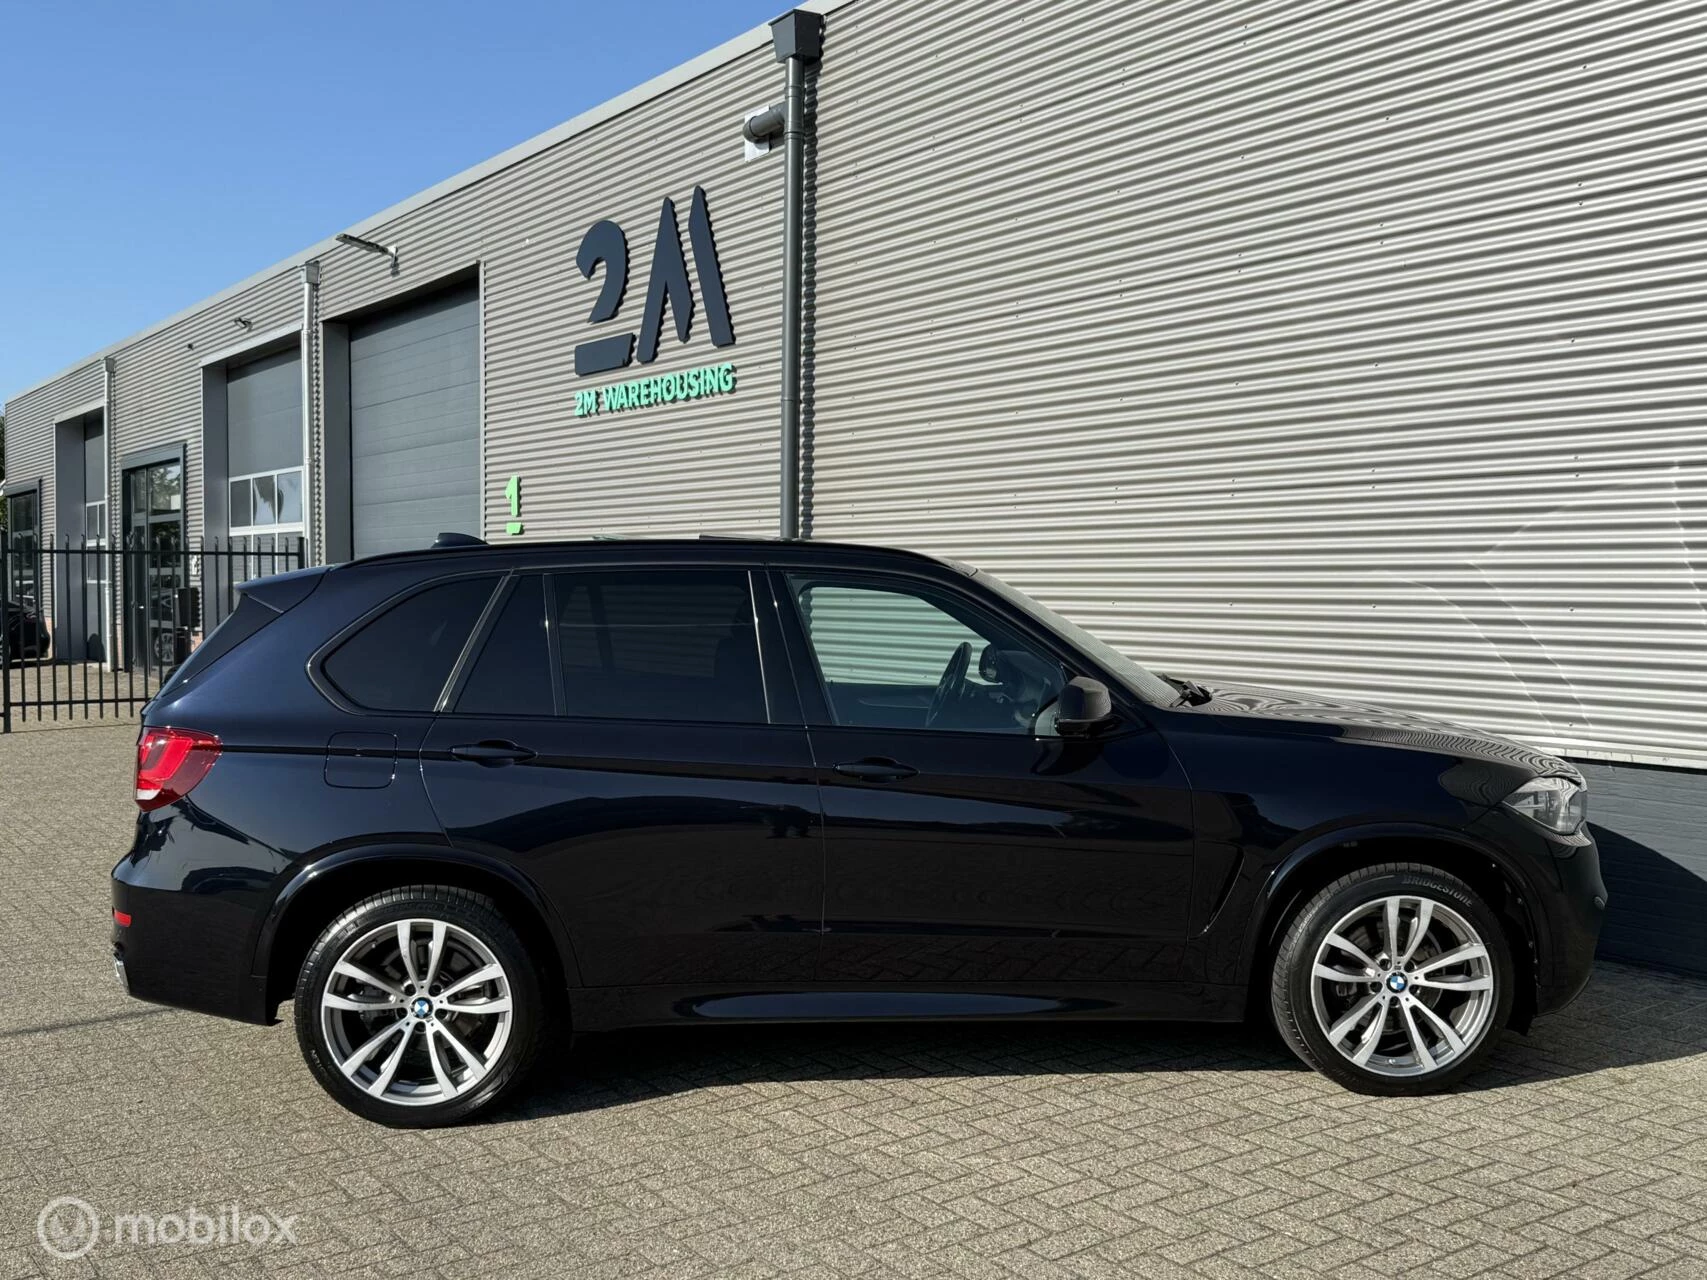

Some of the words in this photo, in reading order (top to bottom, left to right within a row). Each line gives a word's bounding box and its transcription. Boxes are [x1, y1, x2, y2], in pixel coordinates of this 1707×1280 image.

[575, 185, 735, 376] 2M
[574, 391, 597, 416] 2M
[603, 362, 734, 411] WAREHOUSING
